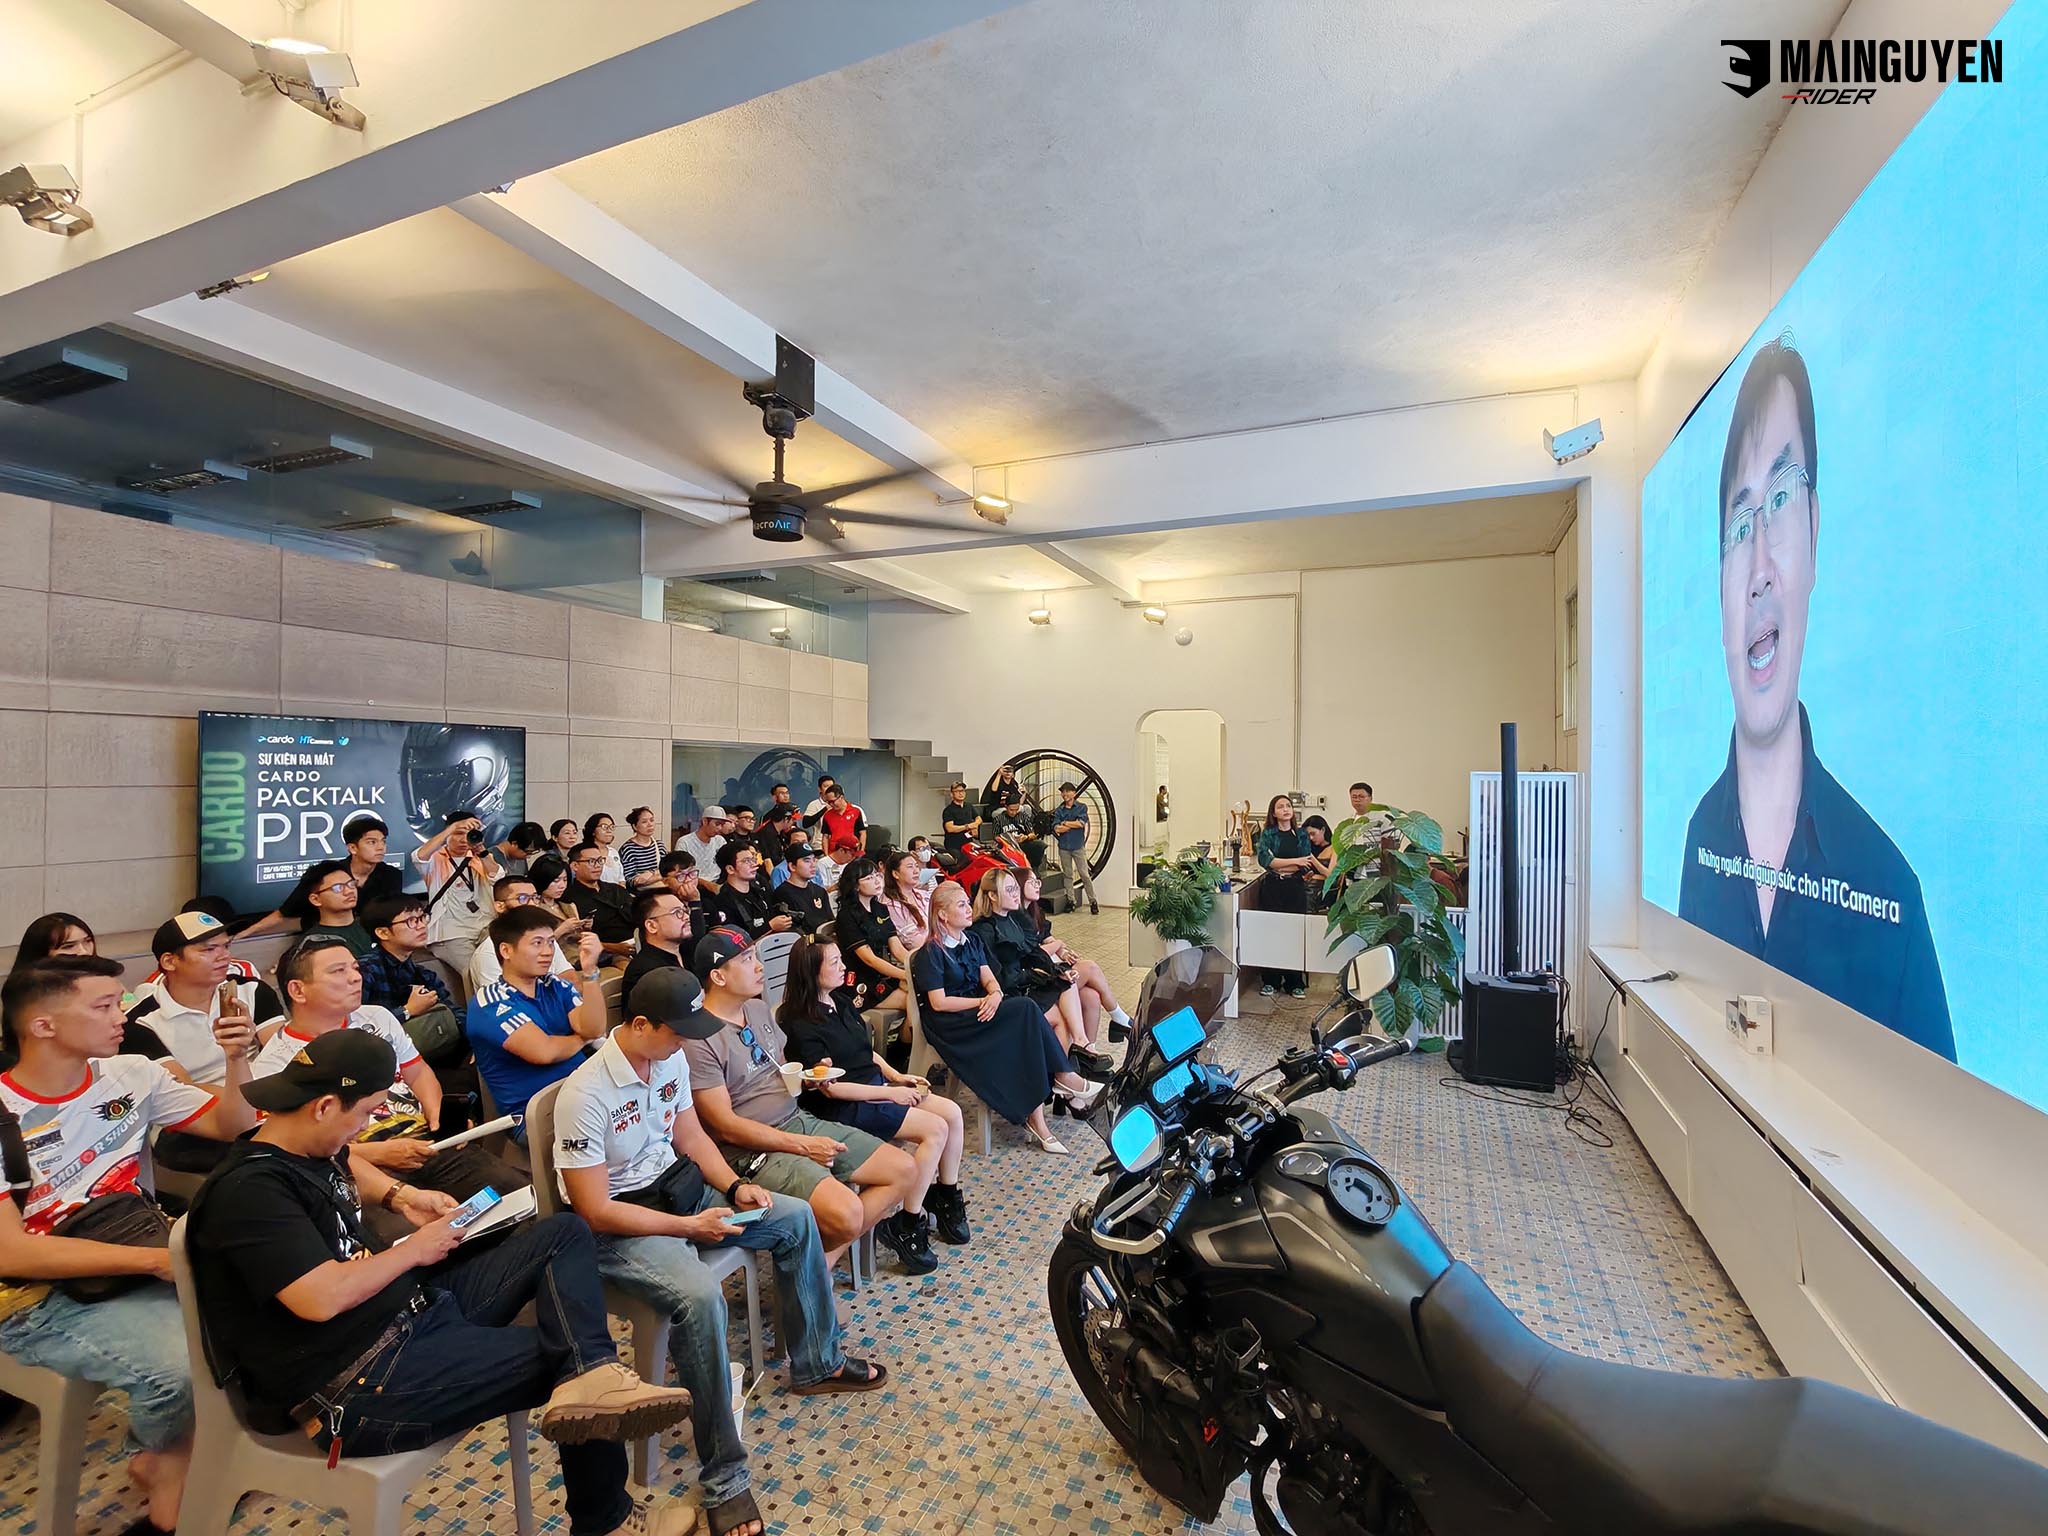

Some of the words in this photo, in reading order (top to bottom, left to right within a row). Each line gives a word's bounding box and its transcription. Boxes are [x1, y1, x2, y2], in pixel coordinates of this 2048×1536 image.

[299, 753, 312, 766] RA
[258, 771, 321, 782] CARDO
[202, 751, 247, 864] CARDO
[256, 786, 385, 808] PACKTALK
[1698, 846, 1720, 874] Những
[1743, 858, 1755, 880] đã
[1756, 860, 1777, 892] giúp
[1778, 868, 1797, 892] sức
[1798, 872, 1819, 899] cho
[1821, 876, 1901, 924] HTCamera
[104, 1109, 140, 1147] SHOW
